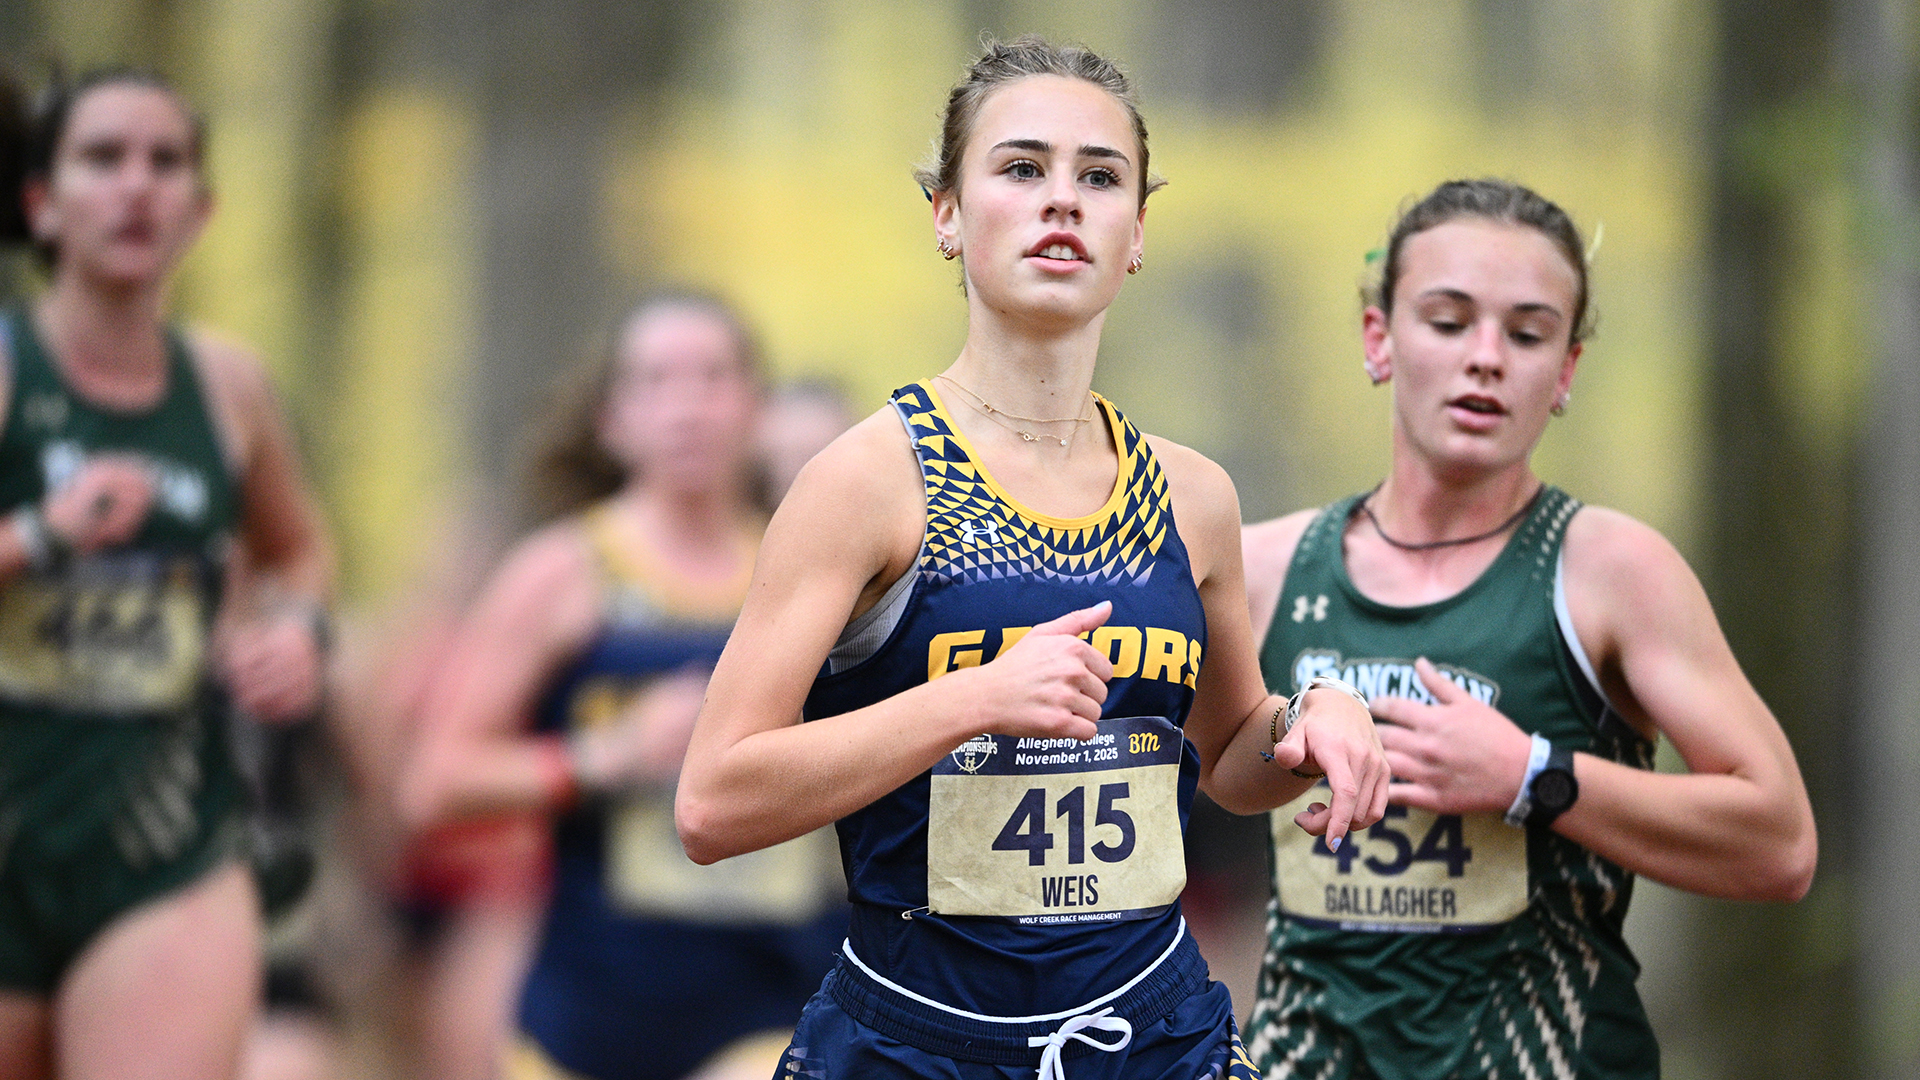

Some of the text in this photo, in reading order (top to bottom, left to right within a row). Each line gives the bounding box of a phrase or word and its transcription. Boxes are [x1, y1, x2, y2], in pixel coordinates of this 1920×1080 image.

[926, 626, 1202, 691] GORS
[1015, 747, 1119, 765] November 1, 2025
[1016, 737, 1077, 751] Allegheny
[991, 781, 1137, 867] 415
[1041, 874, 1099, 908] WEIS
[1325, 883, 1457, 919] GALLAGHER
[1078, 912, 1122, 921] MANAGEMENT
